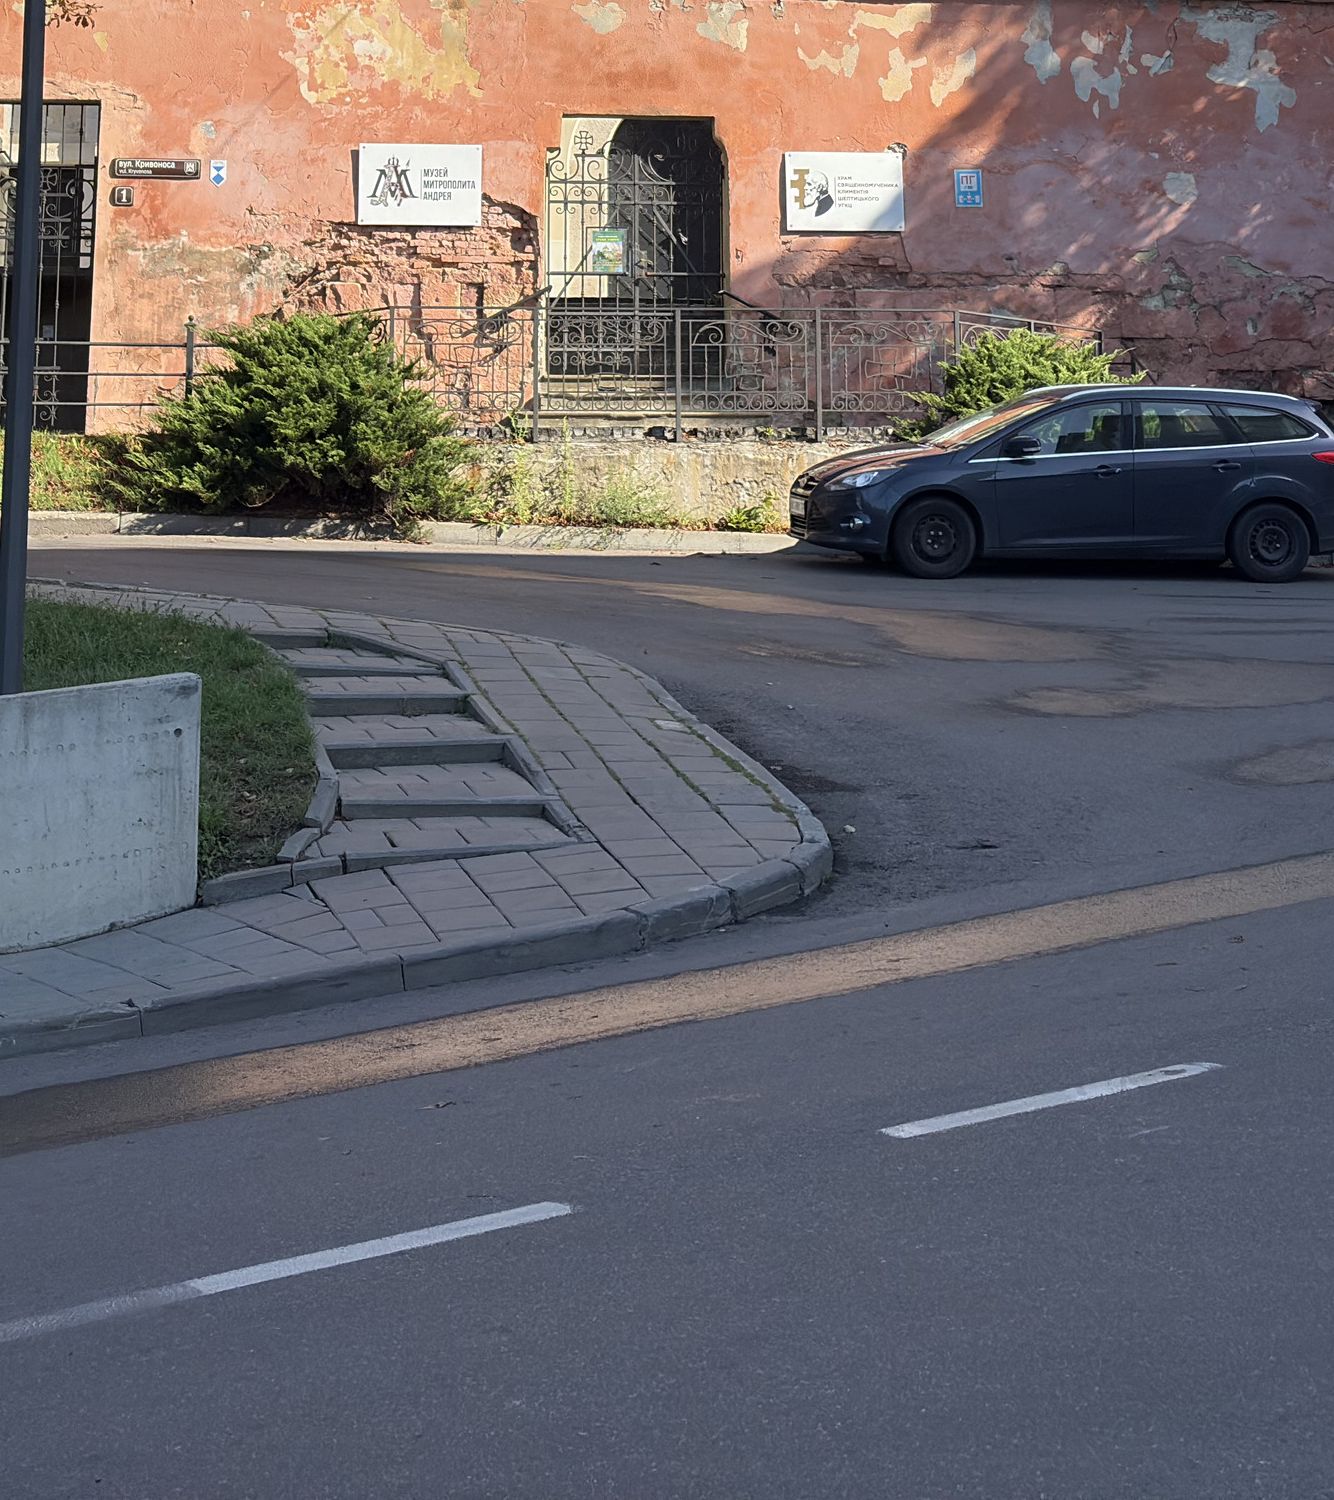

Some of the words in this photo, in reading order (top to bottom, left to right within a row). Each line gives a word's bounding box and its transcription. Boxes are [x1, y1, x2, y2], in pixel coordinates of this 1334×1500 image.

[118, 160, 133, 169] вул.
[135, 160, 176, 169] Кривоноса
[423, 167, 448, 177] МУЗЕЙ
[423, 180, 476, 189] МИТРОПОЛИТА
[960, 175, 976, 185] ПГ
[120, 189, 128, 202] 1
[423, 192, 452, 201] АНДРЕЯ
